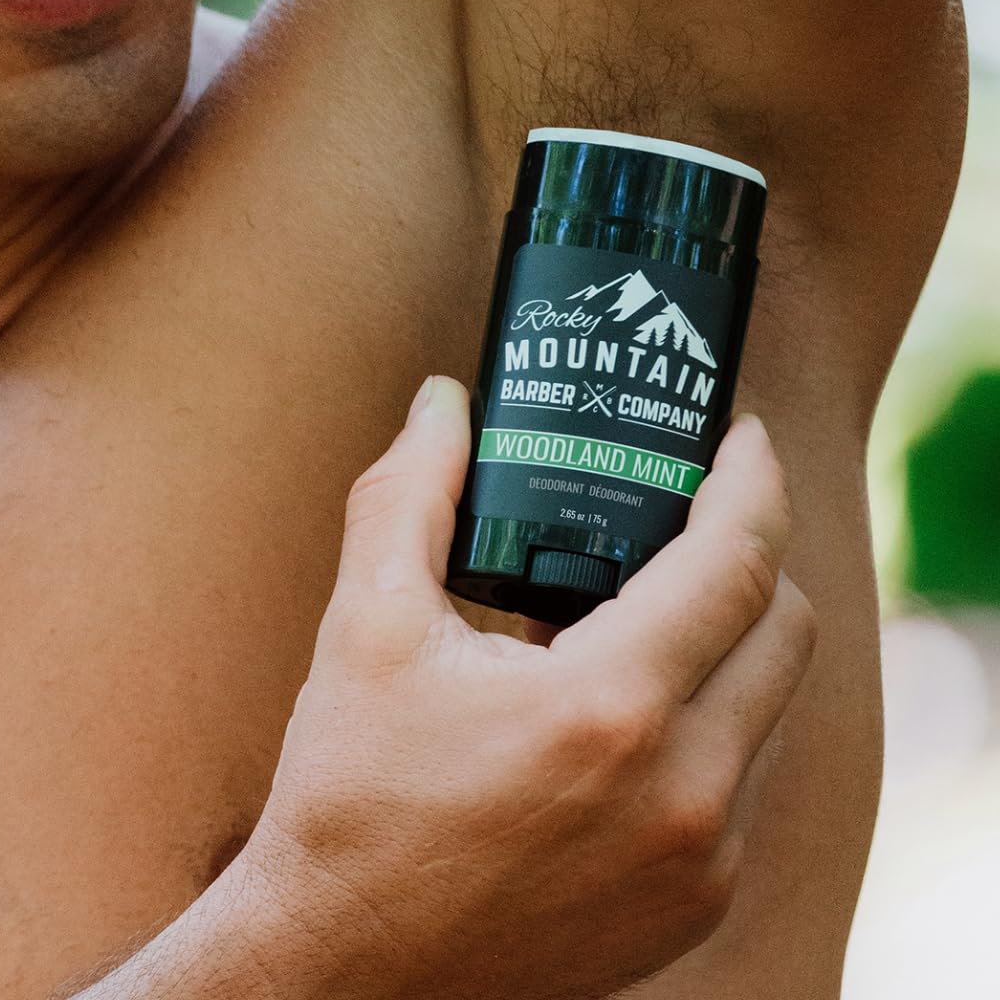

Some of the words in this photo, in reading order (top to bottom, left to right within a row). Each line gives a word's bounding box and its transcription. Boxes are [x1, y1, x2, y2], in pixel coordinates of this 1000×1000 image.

[510, 299, 602, 336] Rocky
[504, 337, 716, 408] MOUNTAIN
[500, 378, 576, 406] BARBER
[617, 393, 707, 435] COMPANY
[496, 432, 627, 473] WOODLAND
[632, 453, 691, 490] MINT
[529, 477, 585, 495] DEODORANT
[588, 483, 644, 508] DÉODORANT
[559, 508, 577, 520] 2.65
[592, 514, 602, 524] 75
